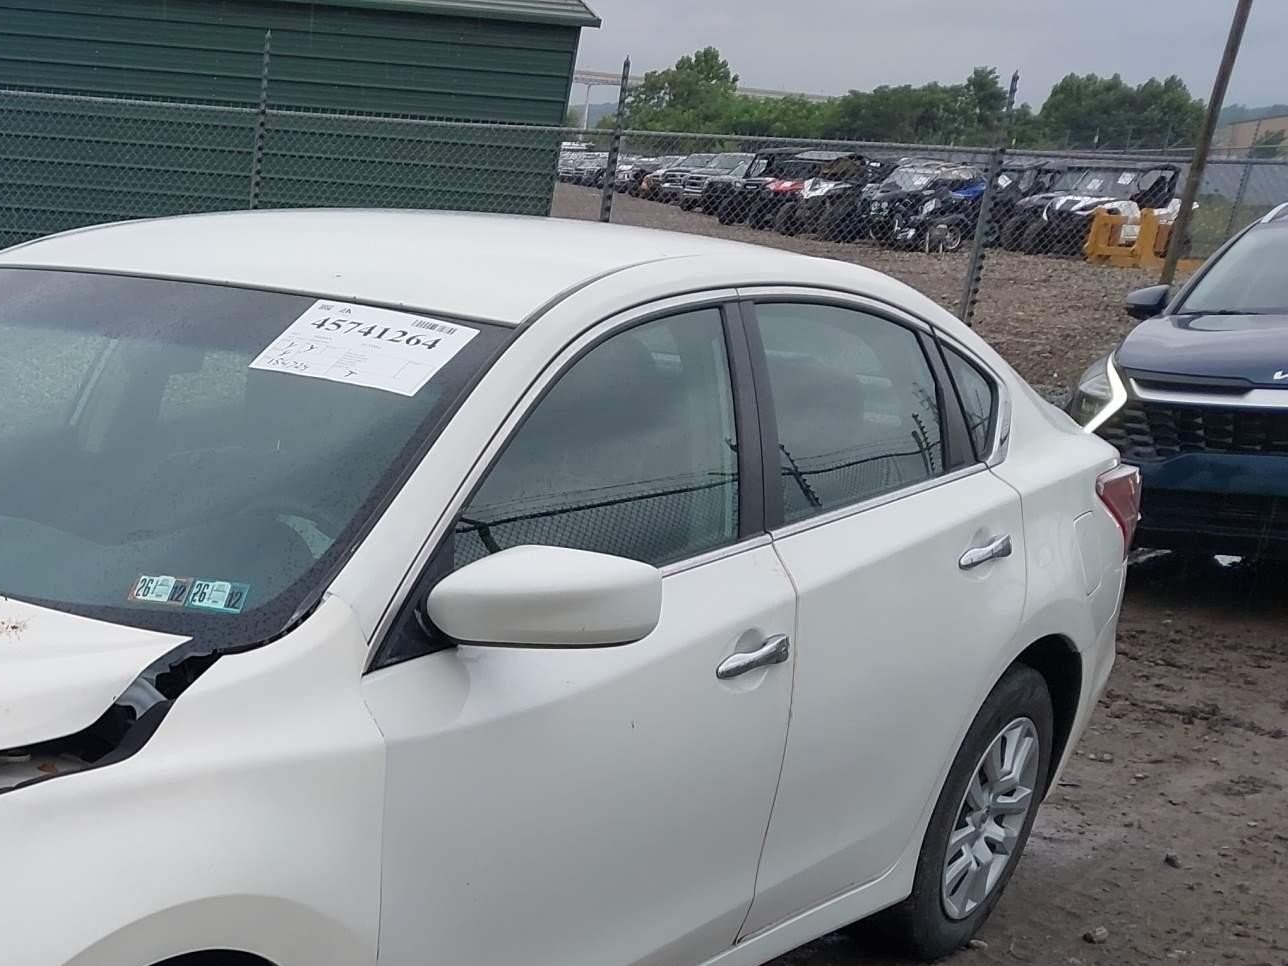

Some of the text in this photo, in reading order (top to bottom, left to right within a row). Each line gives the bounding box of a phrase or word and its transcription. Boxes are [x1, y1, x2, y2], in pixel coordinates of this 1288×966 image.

[311, 316, 443, 350] 45741264
[135, 578, 187, 602] 26 12
[192, 583, 244, 609] 26 12
